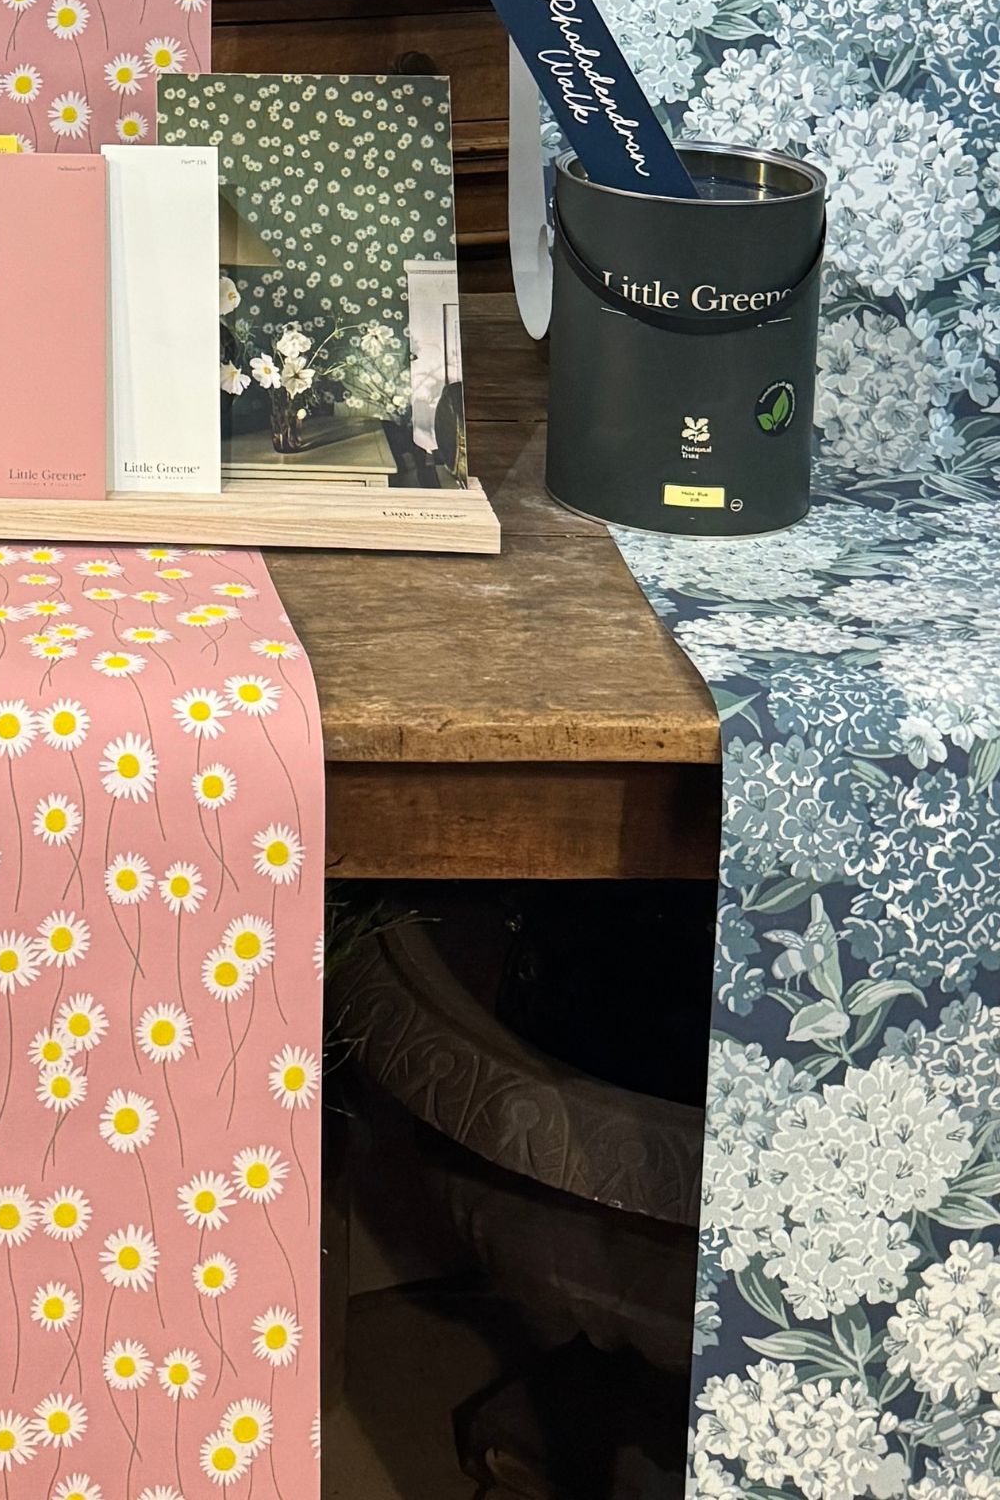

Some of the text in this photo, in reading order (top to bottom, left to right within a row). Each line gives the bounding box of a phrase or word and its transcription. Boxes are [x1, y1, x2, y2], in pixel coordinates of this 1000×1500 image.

[537, 49, 600, 125] Walk
[124, 461, 153, 473] Little
[9, 468, 39, 480] Little
